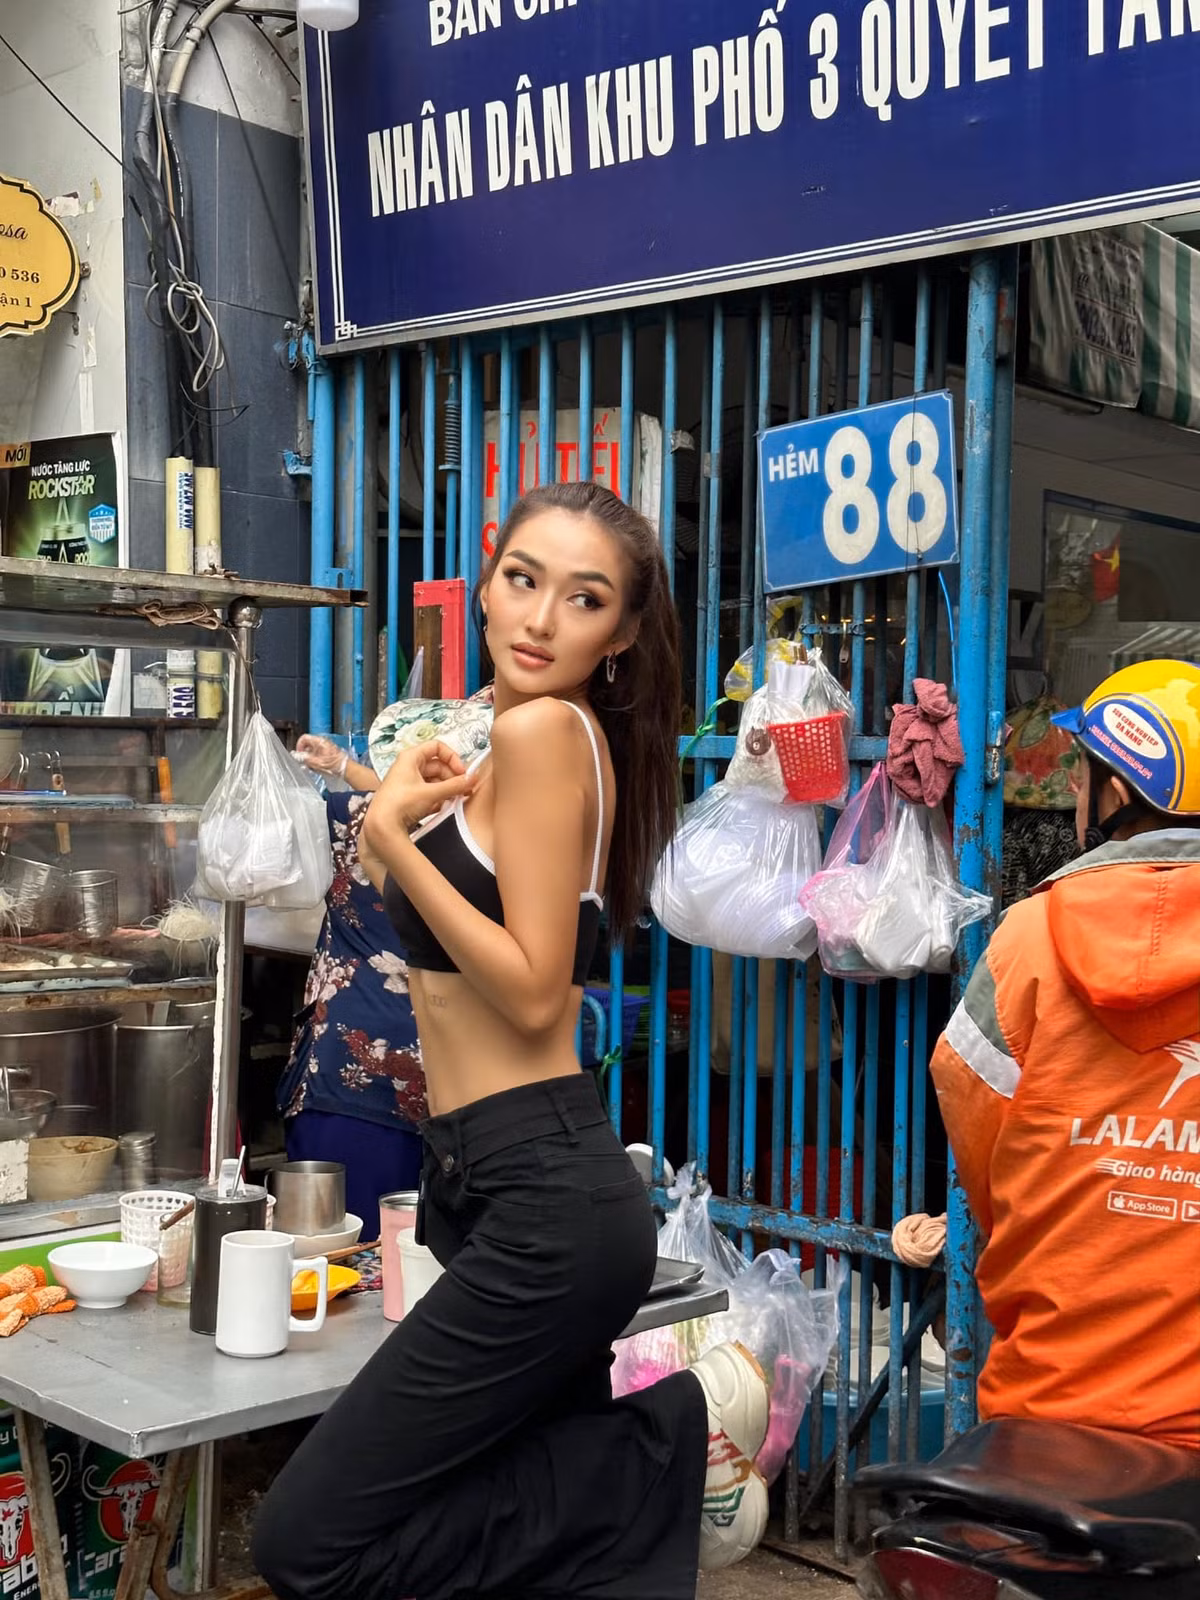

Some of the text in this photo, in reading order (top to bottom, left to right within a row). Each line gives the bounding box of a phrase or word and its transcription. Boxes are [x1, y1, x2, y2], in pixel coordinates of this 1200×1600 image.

[367, 100, 473, 218] NHÂN
[485, 74, 572, 193] DÂN
[585, 55, 674, 170] KHU
[693, 0, 787, 146] PHỐ
[809, 13, 839, 119] 3
[11, 268, 40, 284] 536
[25, 297, 32, 308] 1
[5, 445, 27, 462] MỚI
[31, 459, 91, 477] NƯỚC TĂNG LỰC
[28, 474, 95, 500] ROCKSTAR
[768, 412, 947, 565] HẺM 88
[1112, 1160, 1155, 1180] Giao
[1127, 1199, 1170, 1213] App Store
